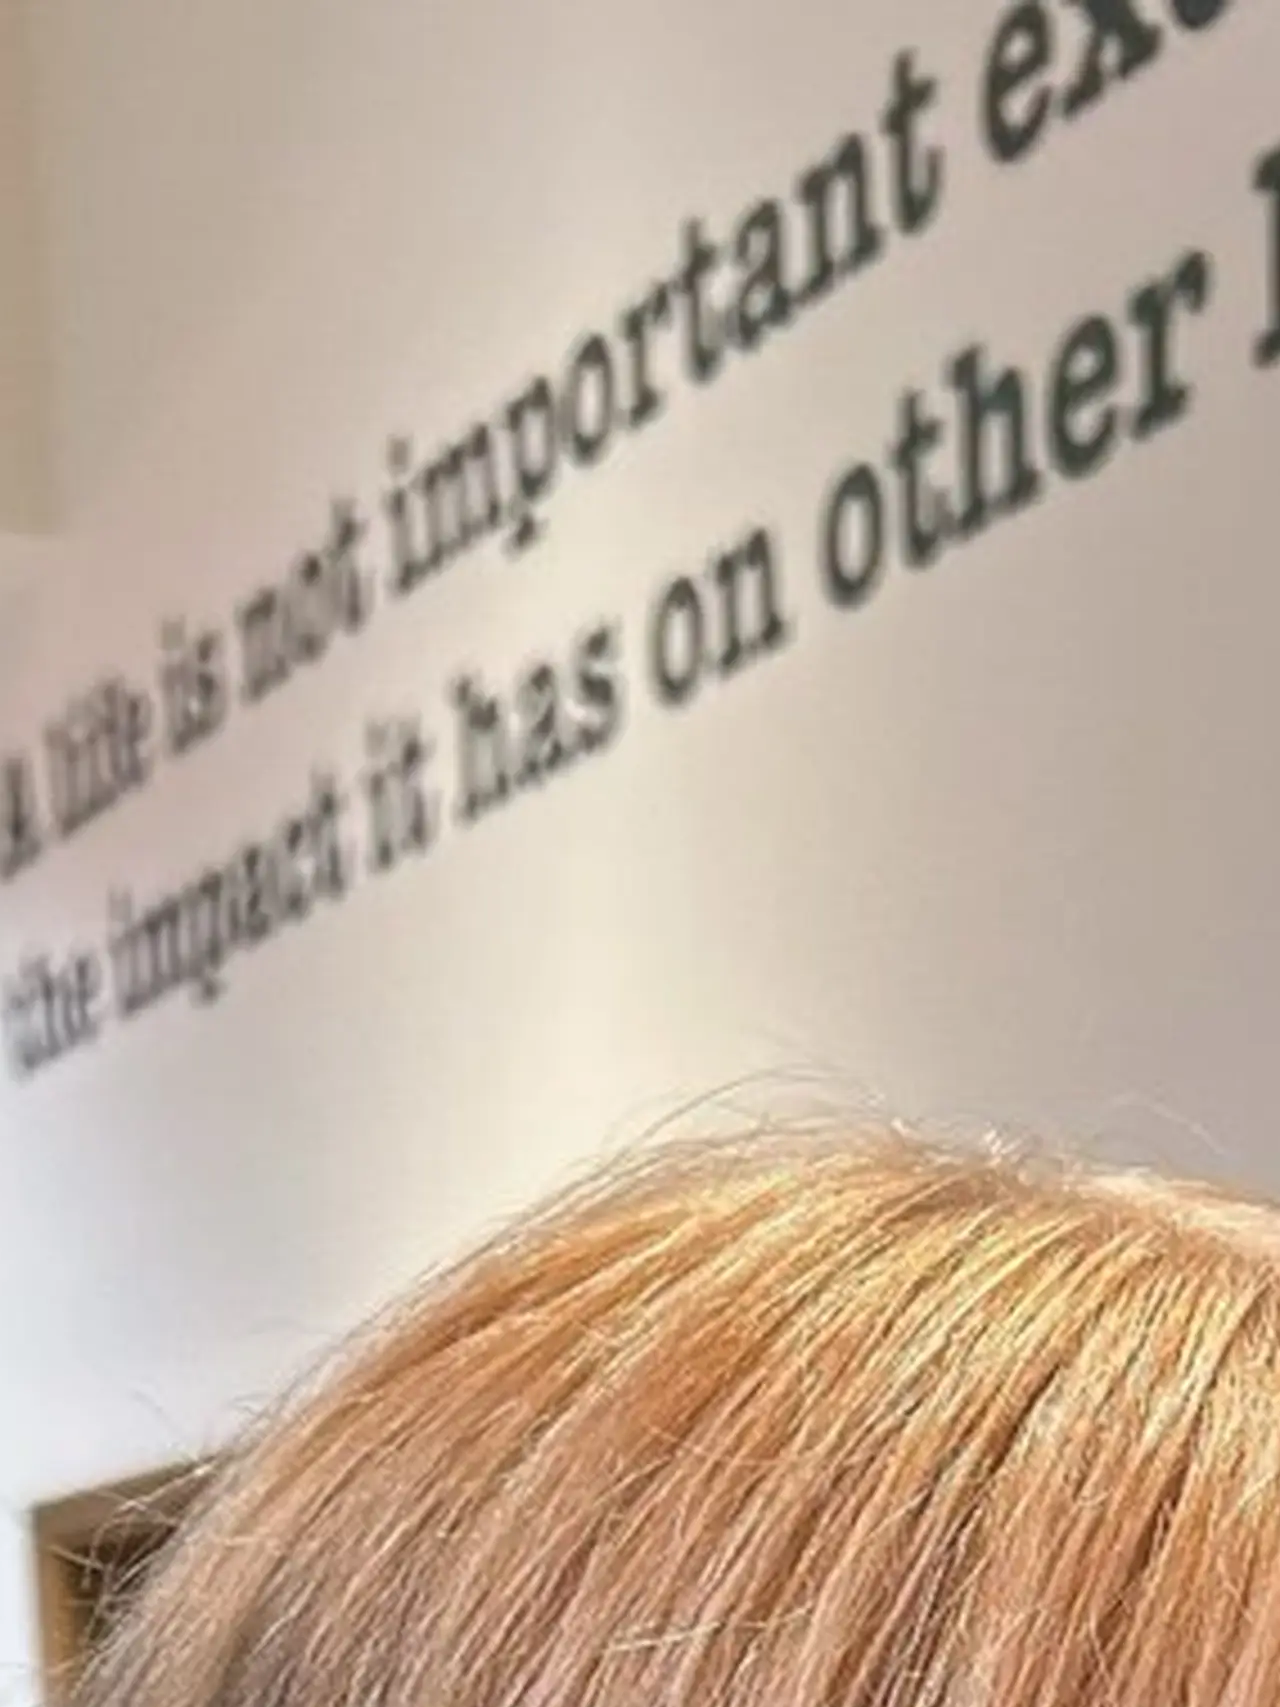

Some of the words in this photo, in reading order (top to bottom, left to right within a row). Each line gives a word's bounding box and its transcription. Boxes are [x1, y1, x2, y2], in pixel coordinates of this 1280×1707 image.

[4, 946, 102, 1076] the
[111, 773, 348, 1017] impact
[367, 713, 437, 873] it
[451, 624, 623, 824] has
[648, 526, 789, 709] on
[819, 250, 1210, 611] other
[48, 674, 154, 839] life
[160, 622, 224, 755] is
[239, 500, 368, 702] not
[384, 51, 943, 597] important
[979, 0, 1230, 164] ex
